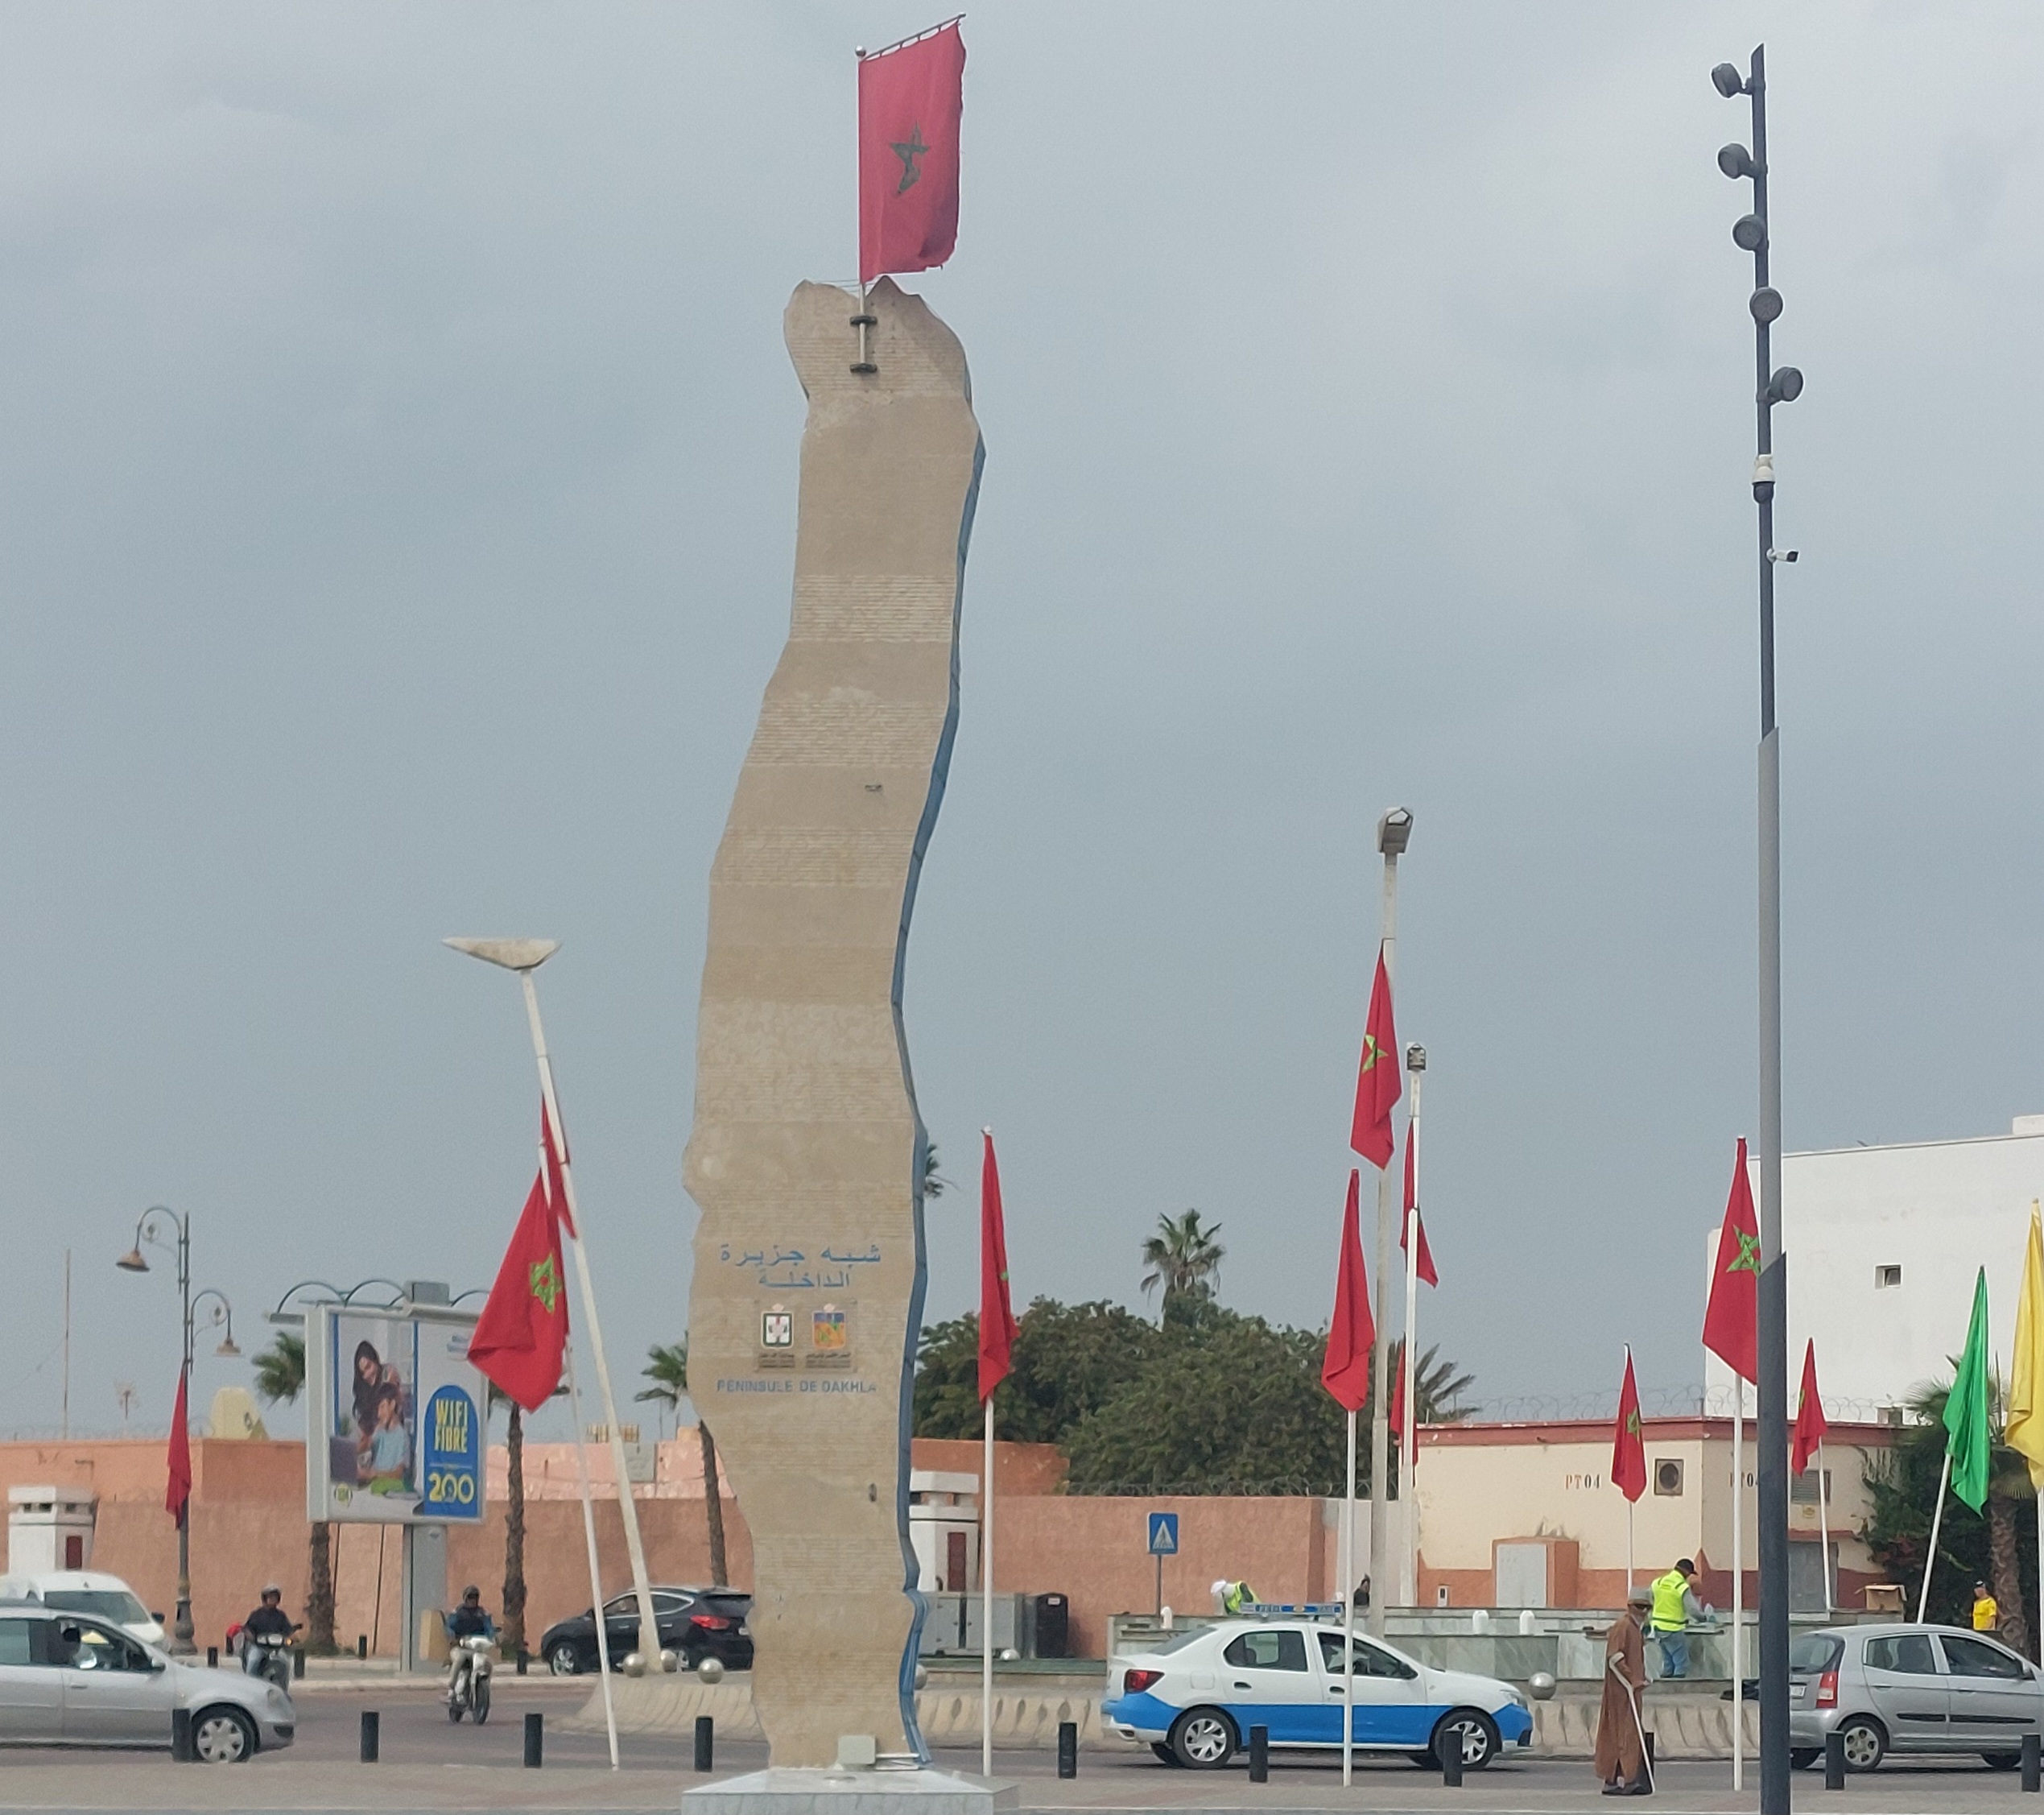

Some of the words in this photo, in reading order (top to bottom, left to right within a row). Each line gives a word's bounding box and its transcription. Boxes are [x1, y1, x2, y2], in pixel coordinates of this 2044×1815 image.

[721, 1244, 805, 1267] جزيرة
[821, 1245, 881, 1268] شبه
[759, 1267, 850, 1288] الداخلة
[799, 1379, 818, 1393] DE
[821, 1379, 877, 1394] DAKHLA
[436, 1398, 469, 1426] WIFI
[428, 1472, 475, 1504] 200
